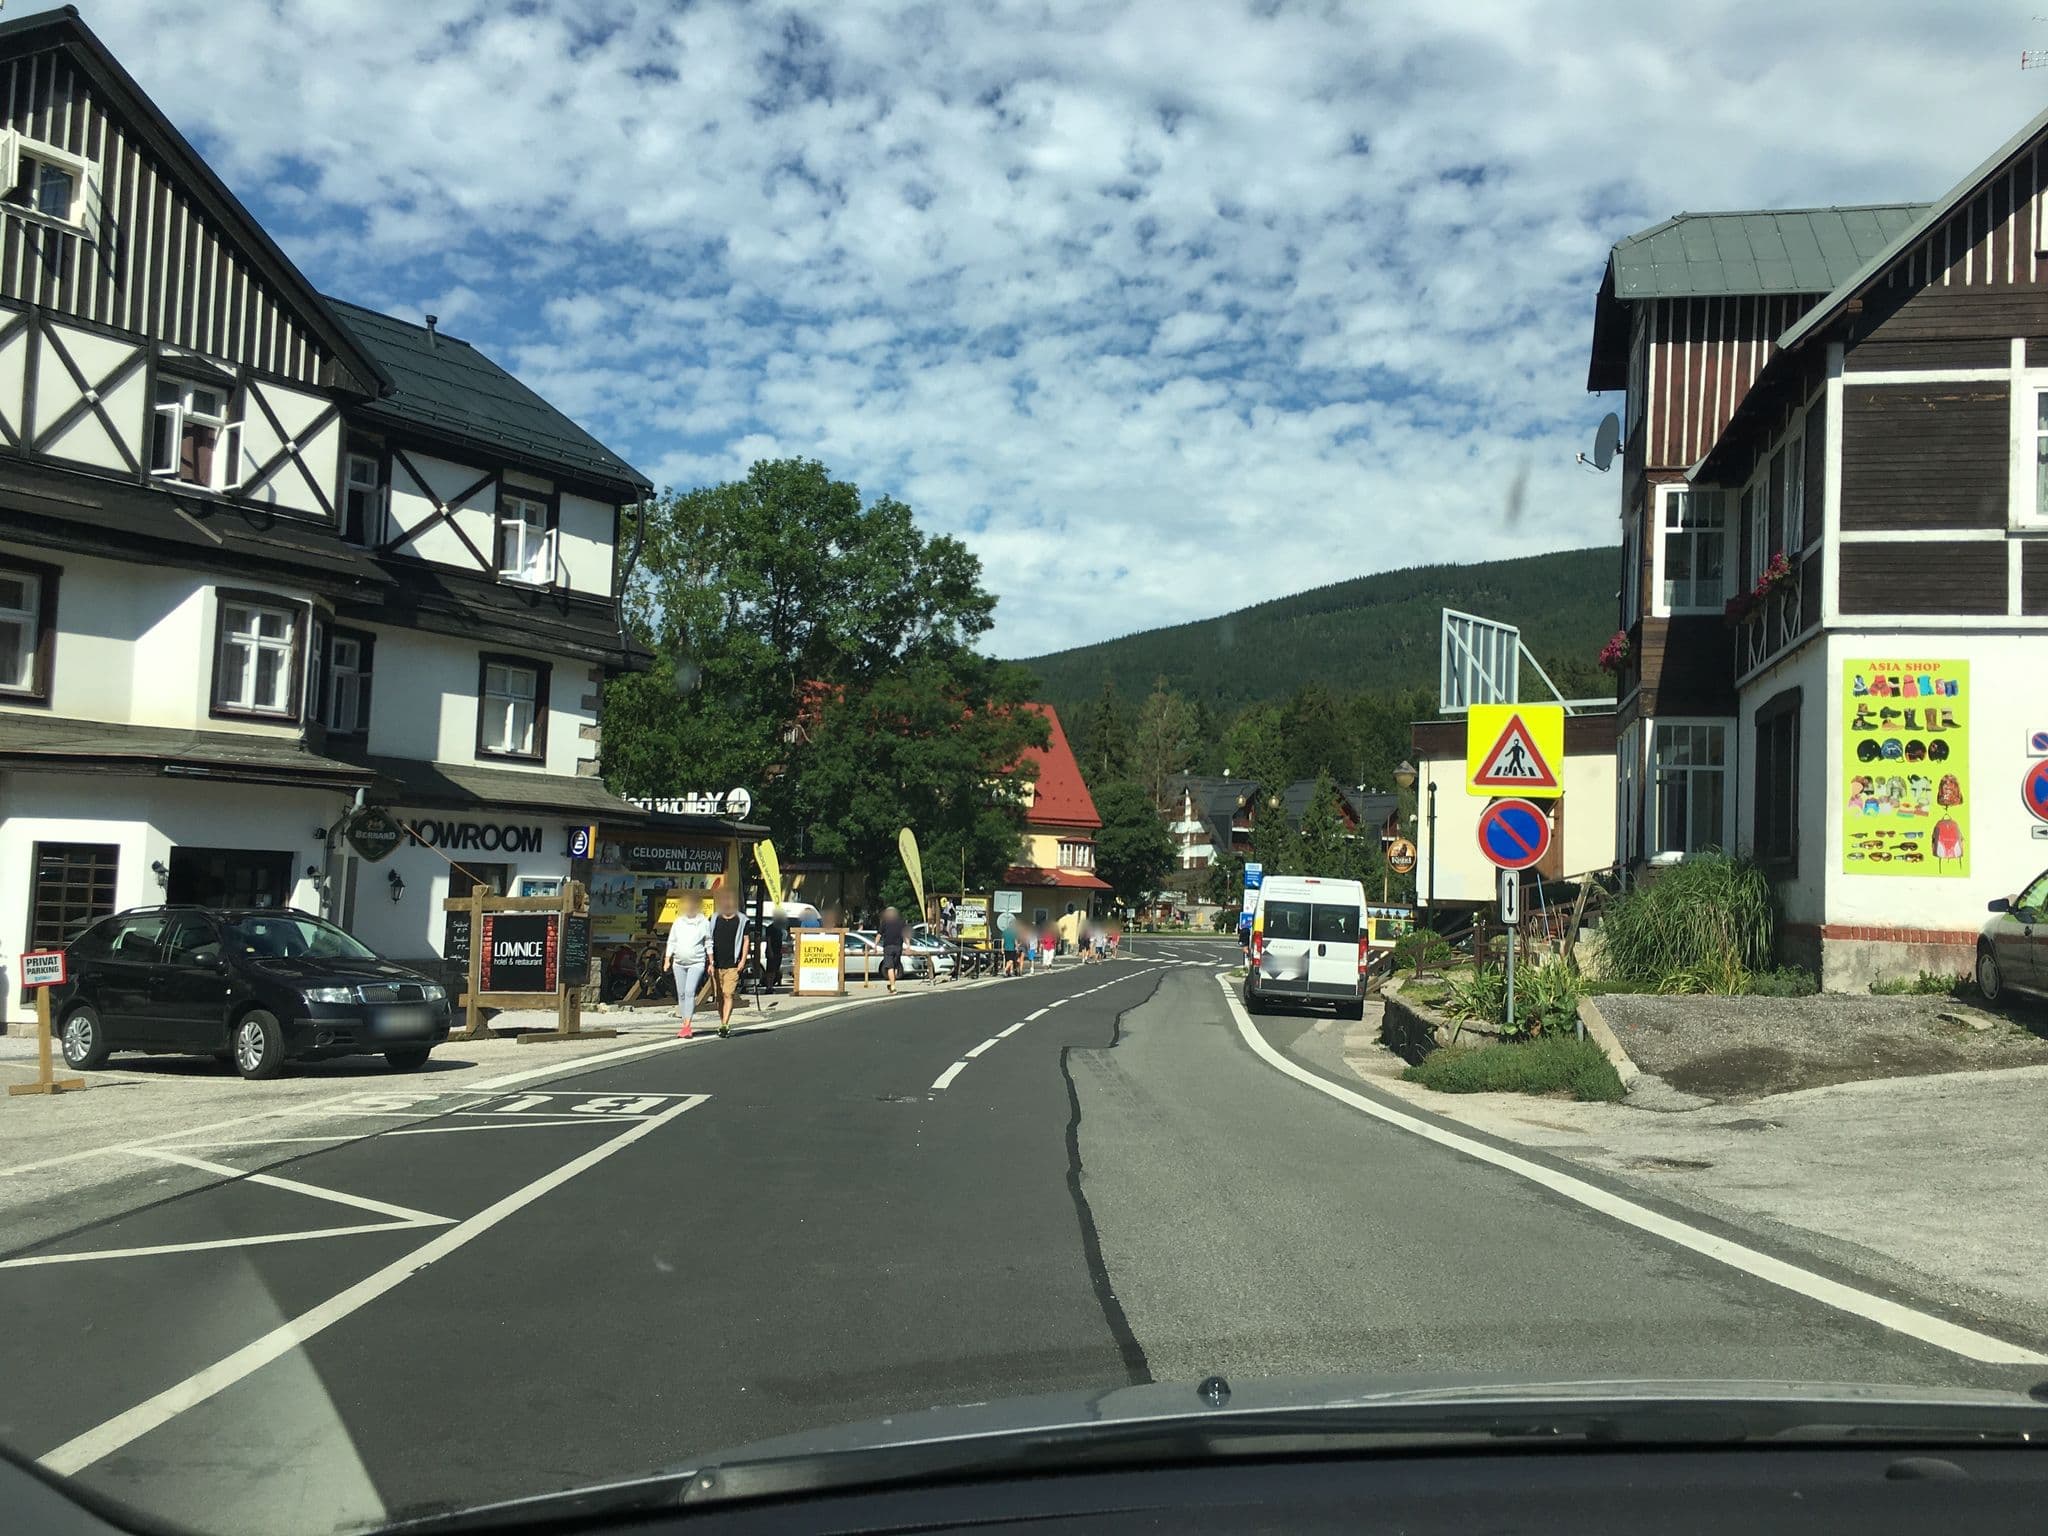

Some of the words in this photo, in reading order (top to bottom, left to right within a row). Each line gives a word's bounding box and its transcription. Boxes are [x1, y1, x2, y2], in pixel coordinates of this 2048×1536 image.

[1868, 662, 1901, 672] ASIA
[1905, 662, 1941, 672] SHOP
[397, 819, 543, 853] HOWROOM
[633, 846, 688, 860] CELODENNÍ
[665, 860, 680, 871] ALL
[684, 861, 702, 873] DAY
[704, 861, 722, 873] FUN
[494, 941, 543, 958] LOMNICE
[804, 945, 825, 953] LETNÍ
[26, 956, 58, 967] PRIVAT
[494, 958, 508, 966] hotel
[515, 958, 543, 966] restaurant
[26, 965, 60, 975] PARKING
